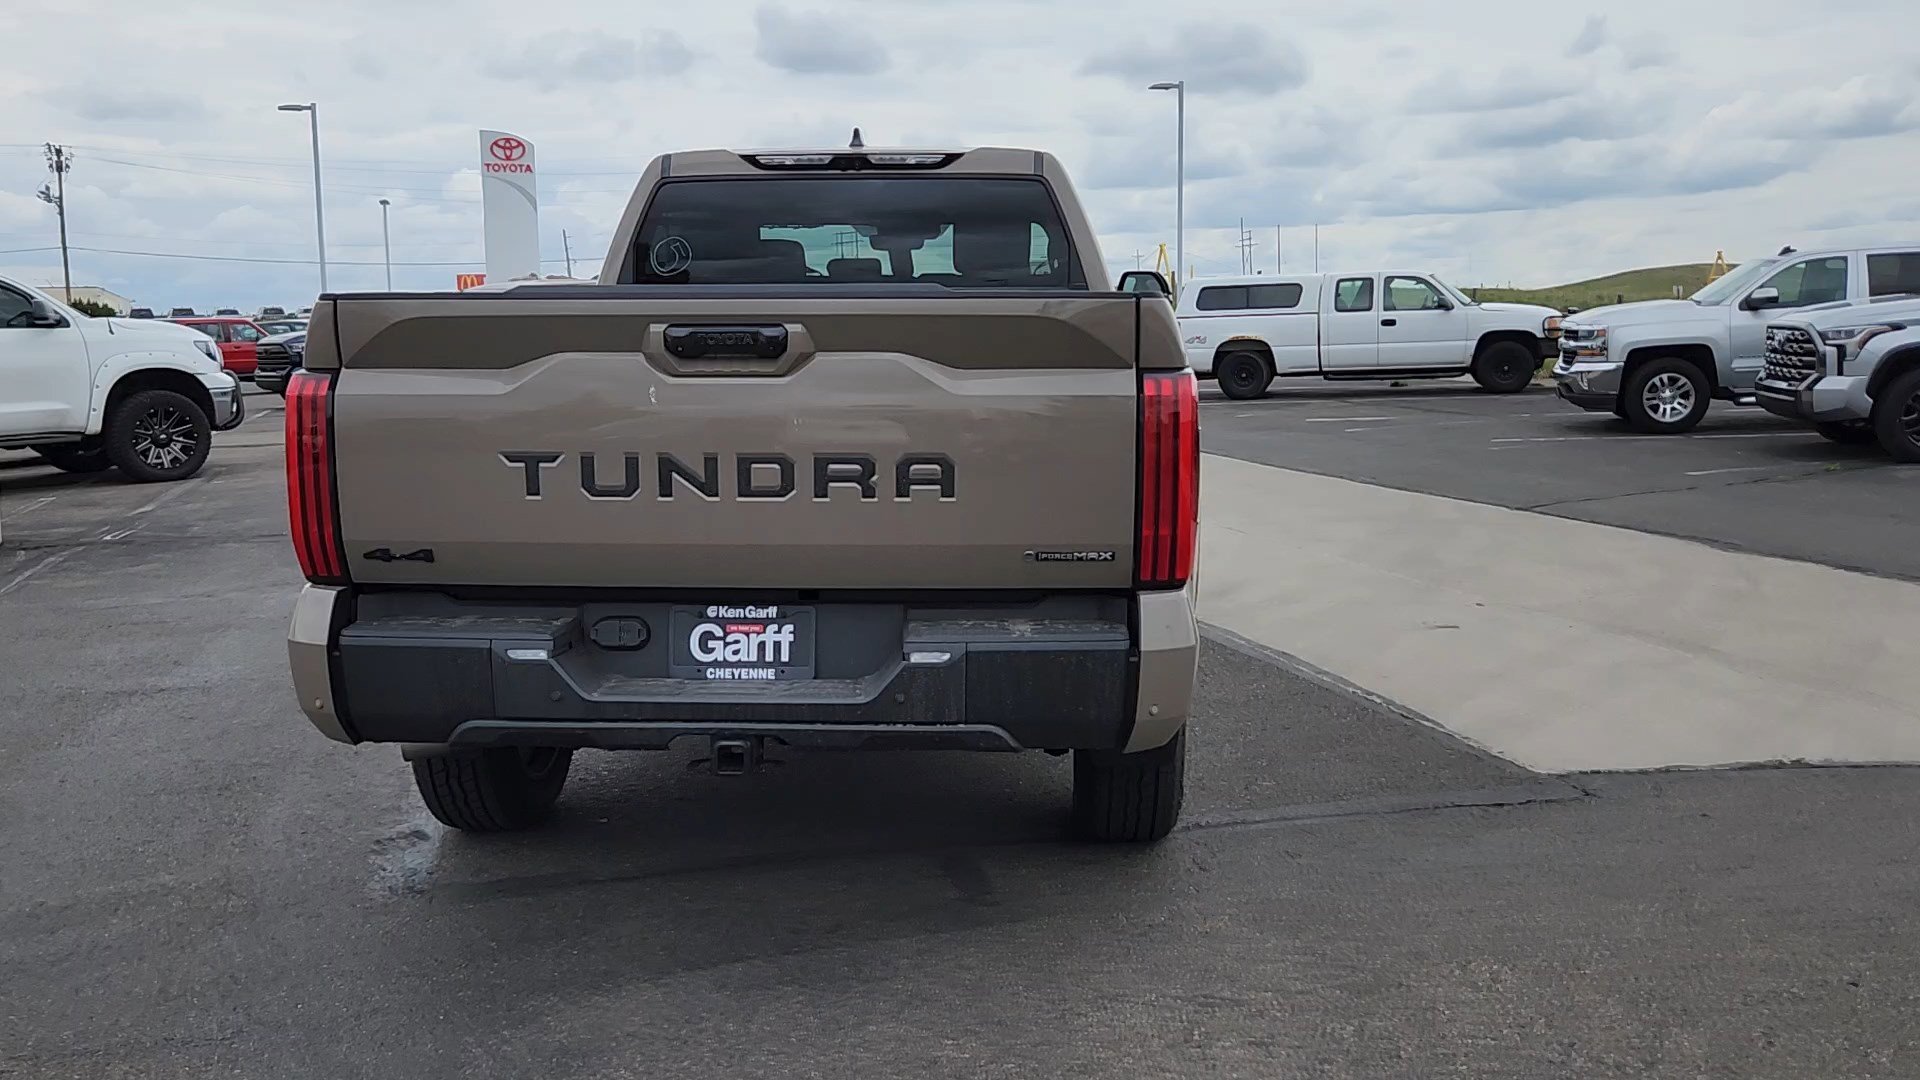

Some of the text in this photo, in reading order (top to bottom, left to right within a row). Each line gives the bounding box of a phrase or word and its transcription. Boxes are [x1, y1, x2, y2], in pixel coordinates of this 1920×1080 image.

[484, 163, 533, 173] TOYOTA
[699, 333, 753, 345] TOYOTA
[498, 450, 957, 502] TUNDRA
[690, 623, 794, 662] Garff
[706, 667, 776, 679] CHEYENNE
